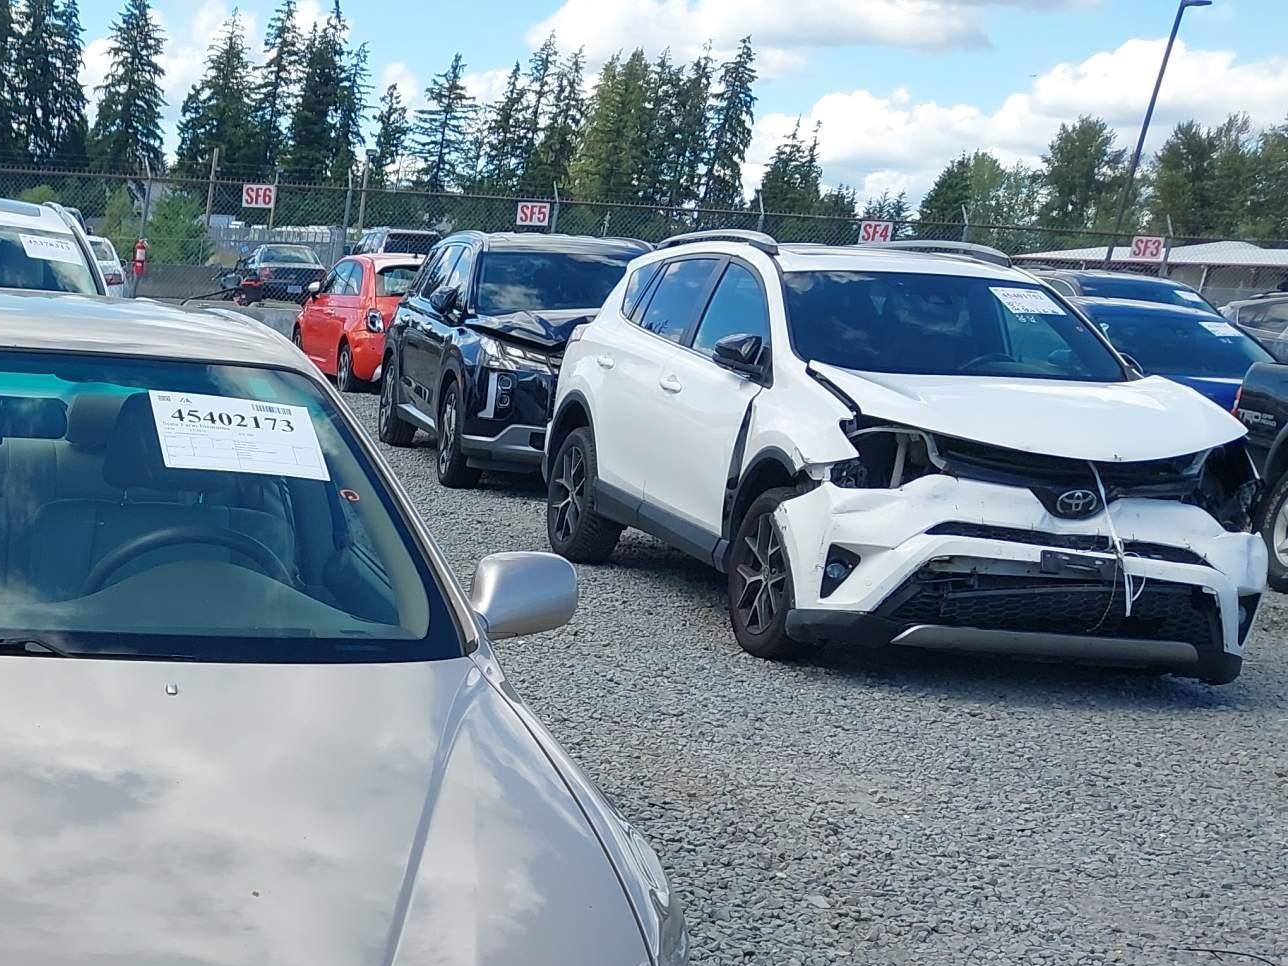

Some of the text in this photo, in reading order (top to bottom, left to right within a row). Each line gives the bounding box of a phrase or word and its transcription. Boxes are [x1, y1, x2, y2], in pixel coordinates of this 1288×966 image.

[245, 187, 272, 205] SF6
[519, 204, 547, 223] SF5
[862, 223, 890, 242] SF4
[1133, 238, 1162, 257] SF3
[171, 408, 295, 433] 45402173
